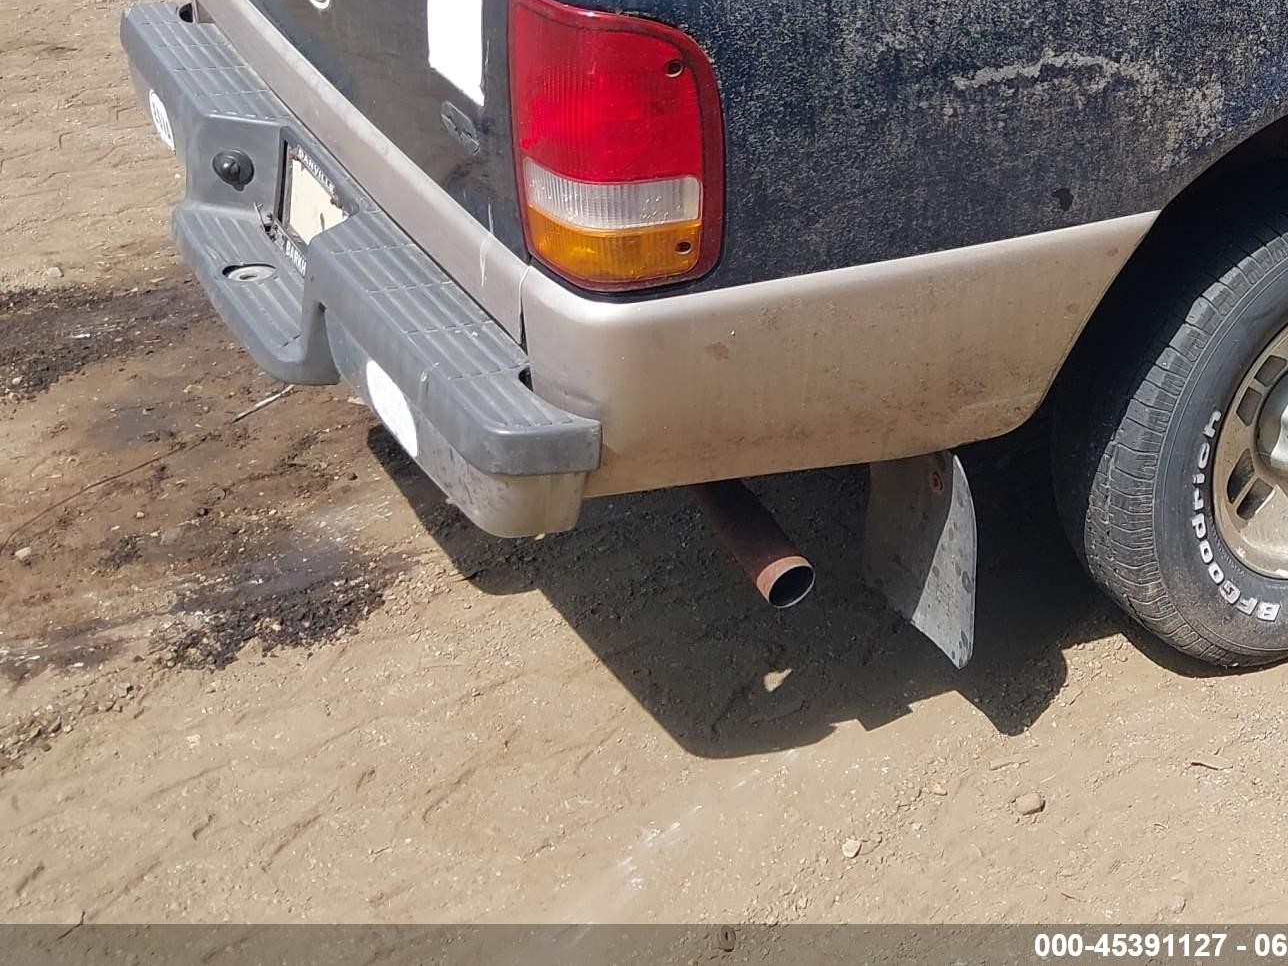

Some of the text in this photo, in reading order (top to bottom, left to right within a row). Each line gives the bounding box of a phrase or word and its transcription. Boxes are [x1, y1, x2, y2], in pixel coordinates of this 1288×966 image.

[298, 144, 335, 195] DANVILLE
[285, 239, 307, 275] BARKH
[1192, 410, 1281, 622] BFGoodrich
